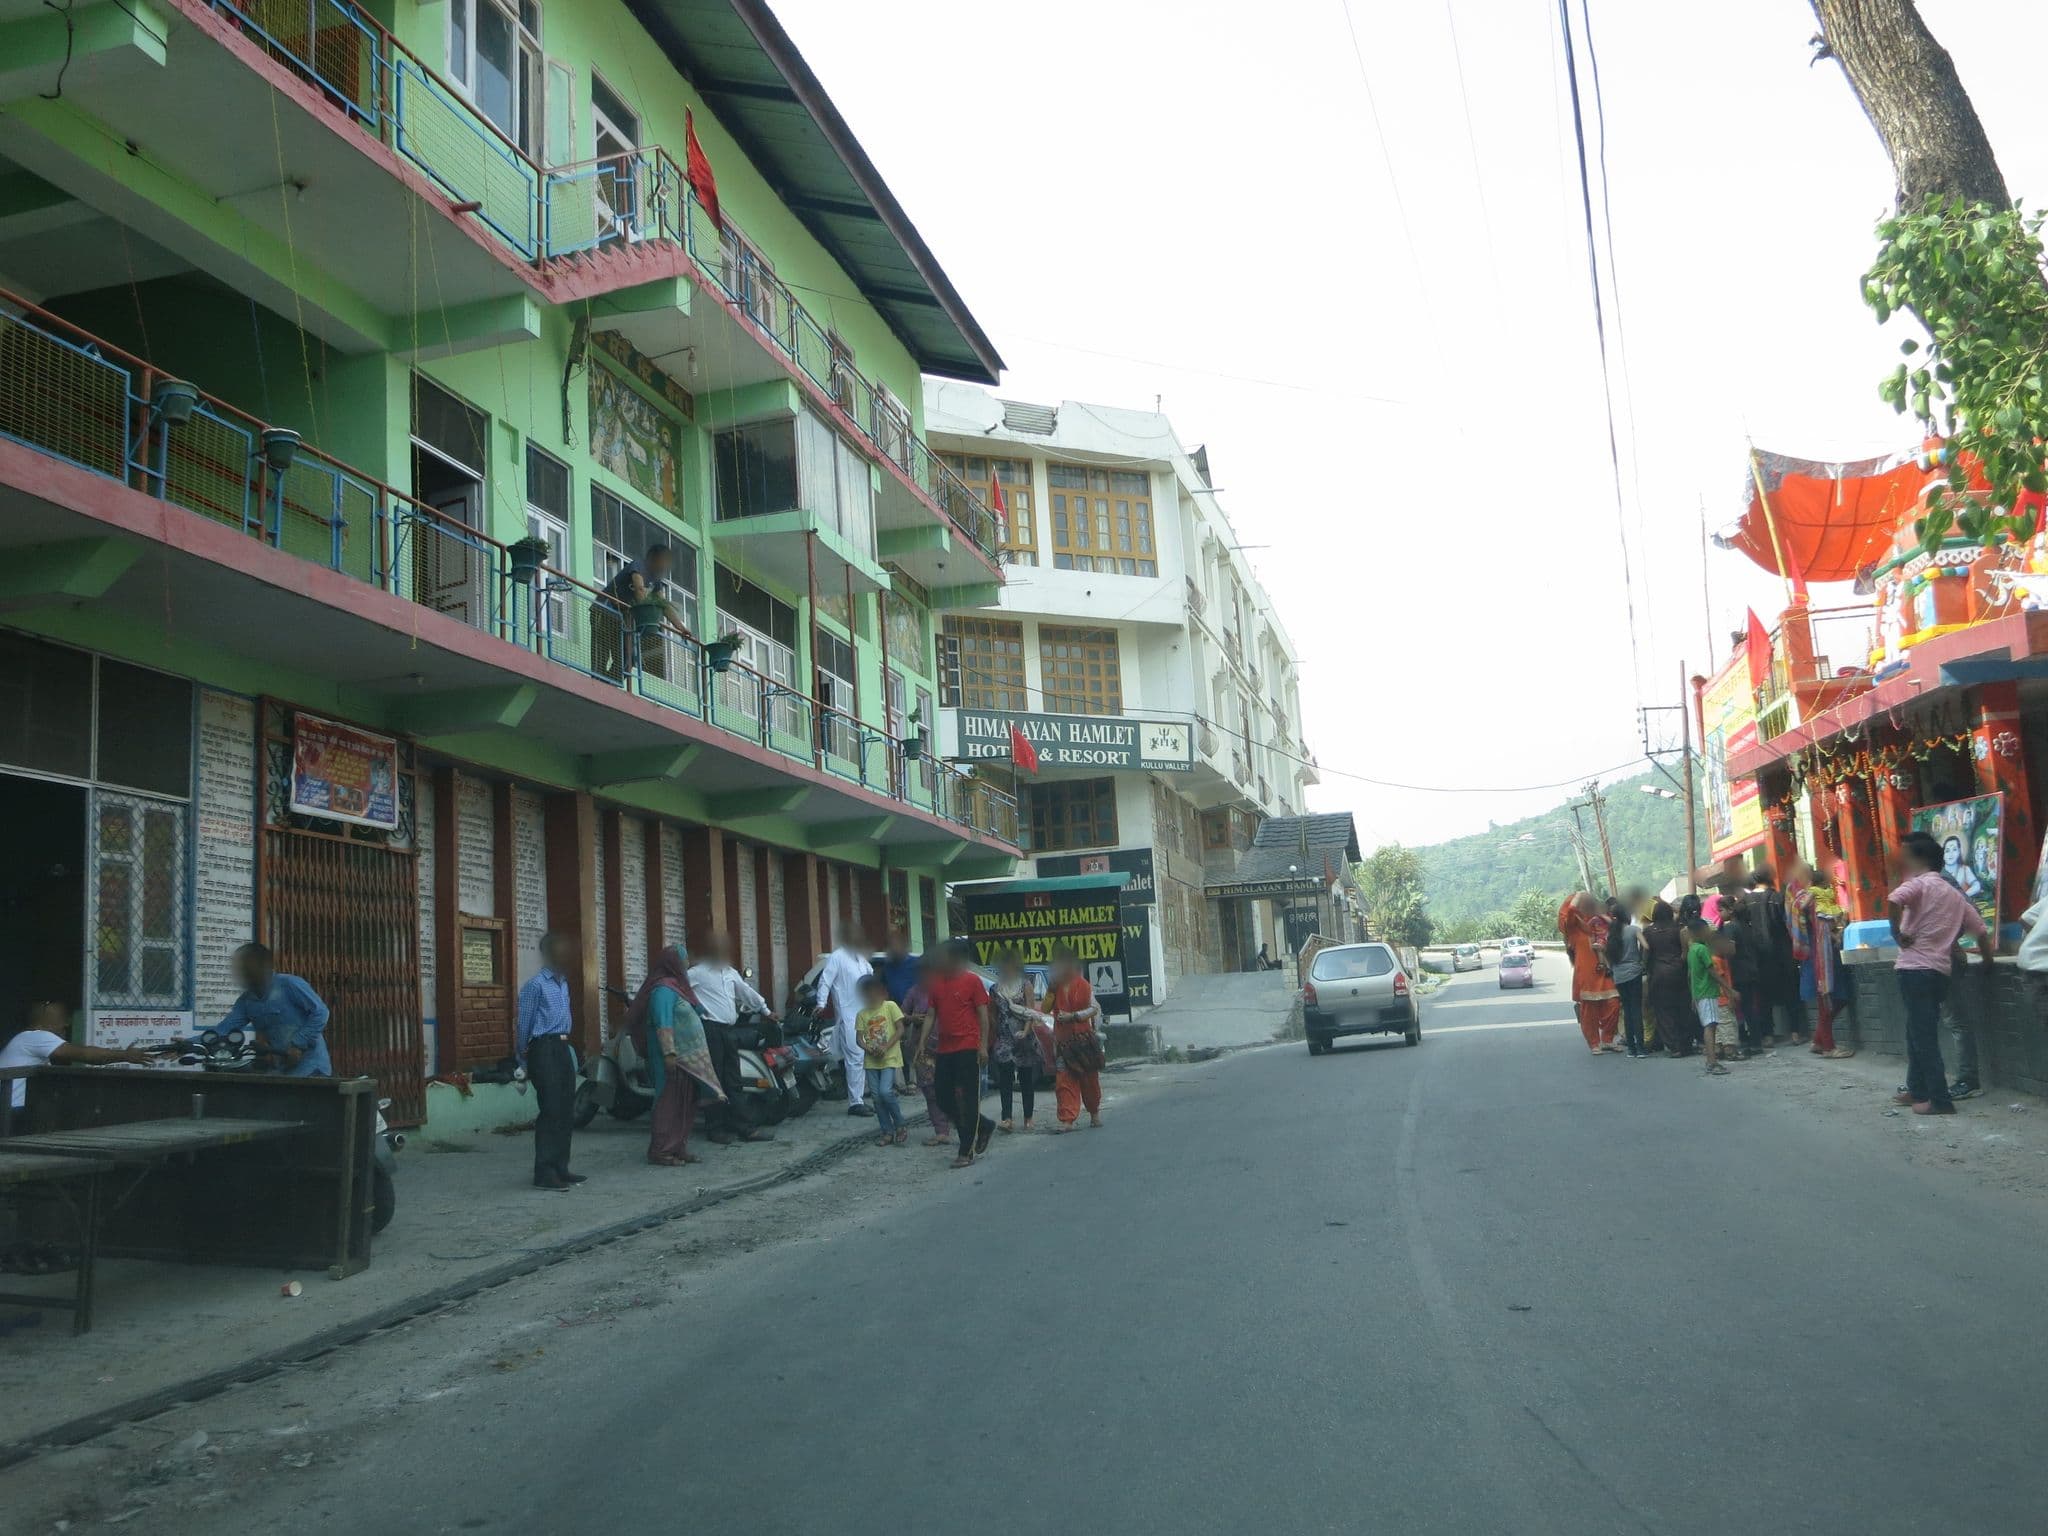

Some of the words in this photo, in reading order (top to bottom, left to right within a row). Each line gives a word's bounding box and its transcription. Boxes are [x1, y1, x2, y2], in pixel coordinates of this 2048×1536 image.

[964, 716, 1061, 742] HIMAAYAN
[1069, 723, 1135, 746] HAMLET
[967, 743, 1010, 758] HOT
[1038, 748, 1053, 761] &
[1058, 748, 1130, 765] RESORT
[1141, 761, 1164, 770] KULLU
[1164, 762, 1191, 771] VALLEY
[1223, 881, 1281, 895] HIMALAYAN
[974, 910, 1056, 931] HIMALAYAN
[1058, 906, 1115, 924] HAMLET
